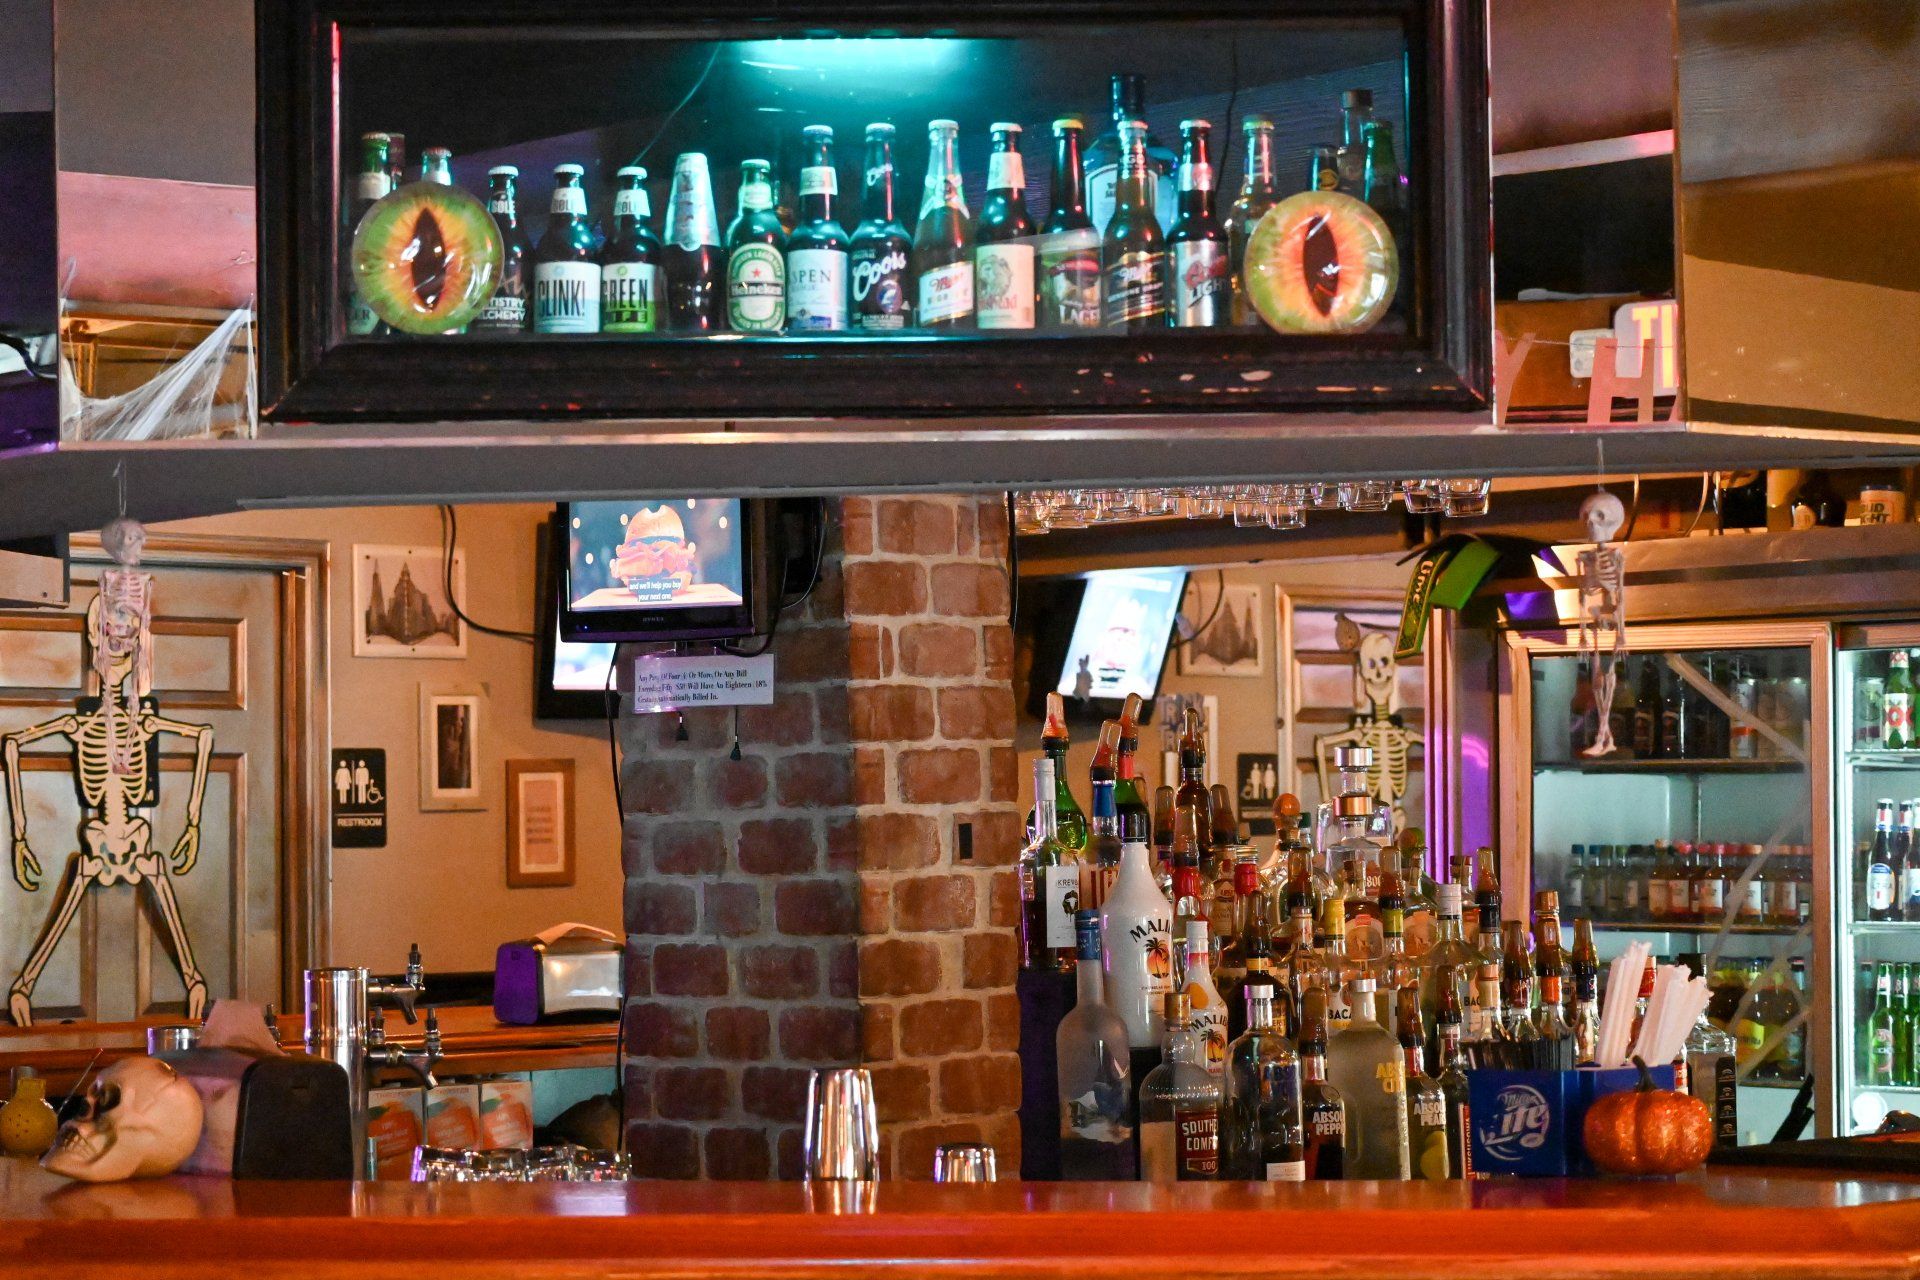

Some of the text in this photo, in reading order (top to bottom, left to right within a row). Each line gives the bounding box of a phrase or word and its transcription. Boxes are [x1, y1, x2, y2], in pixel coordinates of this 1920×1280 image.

[1587, 338, 1679, 425] H
[736, 669, 748, 678] Bill
[687, 682, 699, 690] Will
[700, 682, 714, 690] Have
[716, 681, 724, 689] An
[725, 680, 752, 692] Eighteen
[692, 692, 709, 701] Billed
[337, 818, 382, 827] RESTROOM
